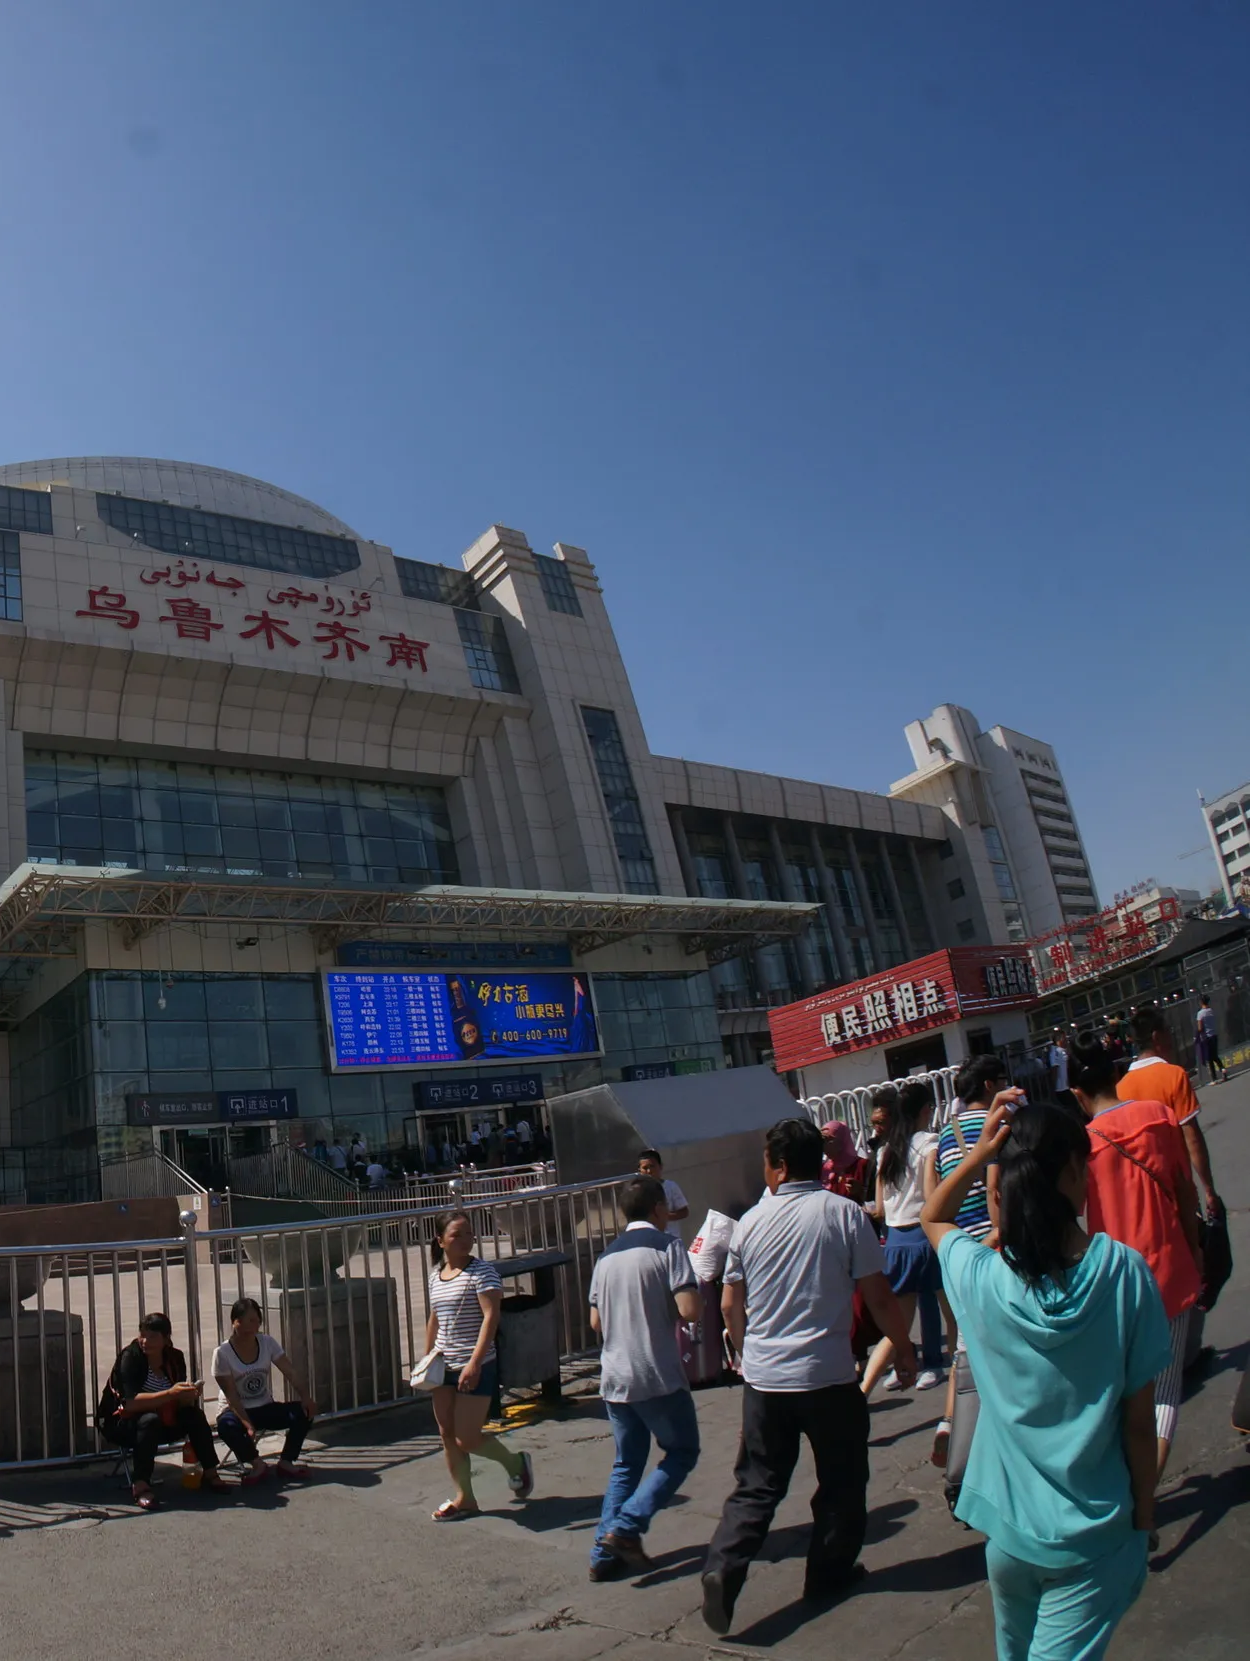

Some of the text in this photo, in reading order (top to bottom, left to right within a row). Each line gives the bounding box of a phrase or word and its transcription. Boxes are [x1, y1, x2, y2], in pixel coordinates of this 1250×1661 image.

[75, 585, 431, 673] 乌鲁木齐南
[334, 975, 347, 983] 车次
[820, 979, 946, 1046] 便民照相点
